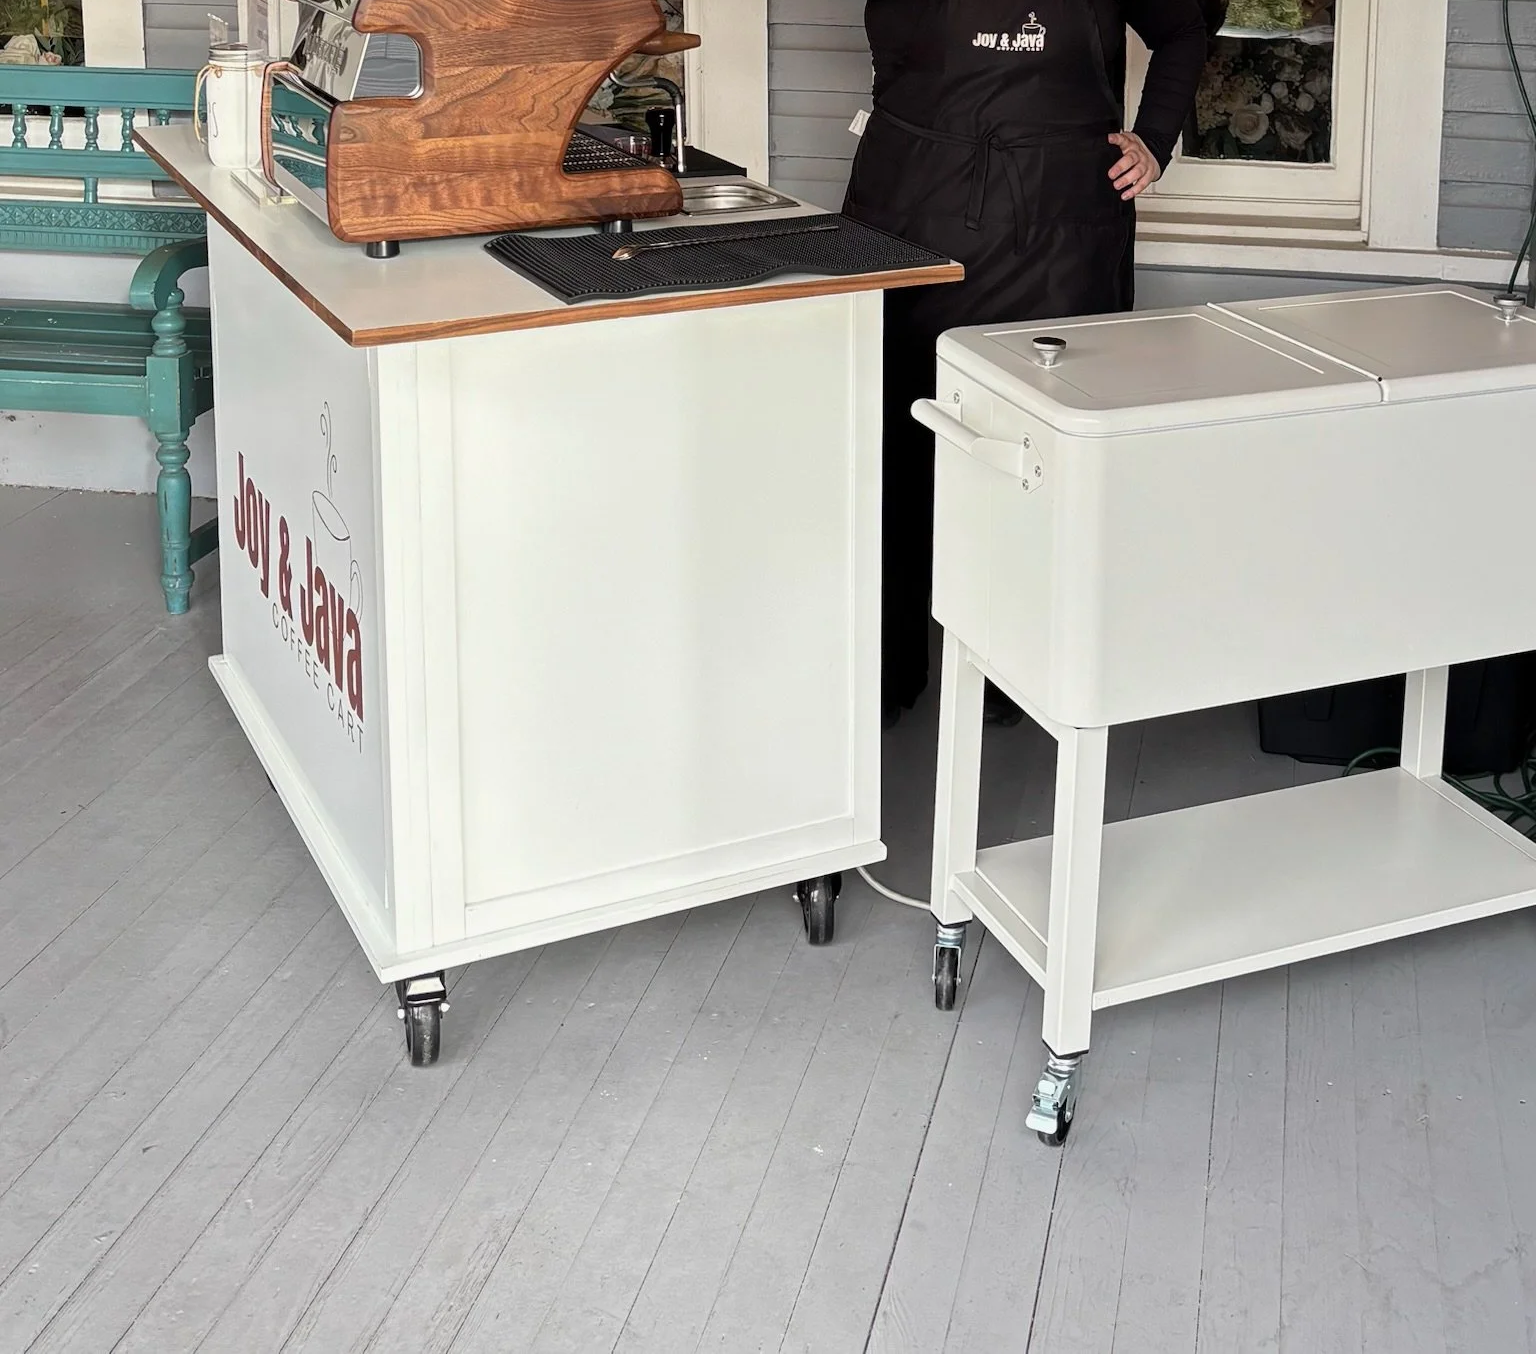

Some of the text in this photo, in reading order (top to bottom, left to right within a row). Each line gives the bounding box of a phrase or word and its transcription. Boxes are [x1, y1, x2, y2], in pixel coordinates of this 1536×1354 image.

[972, 32, 1045, 49] Joy & Java
[234, 451, 364, 723] Joy & Java
[272, 602, 364, 754] COFFEE CART
